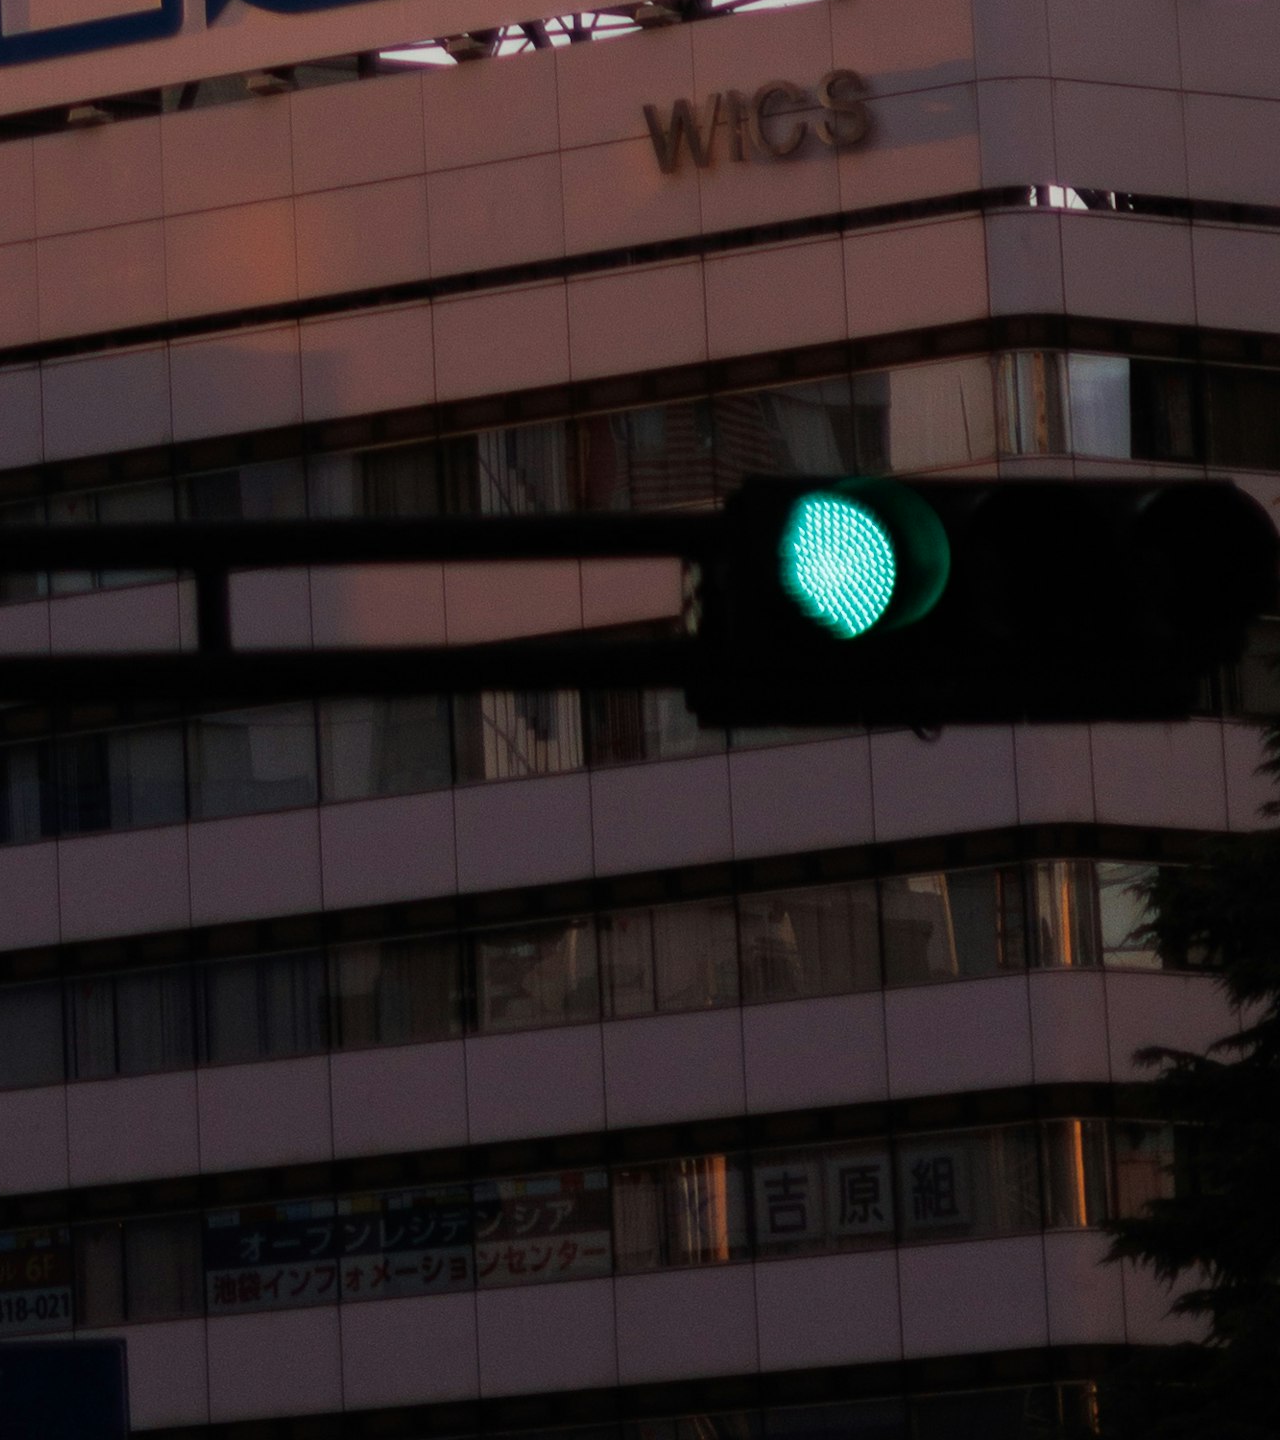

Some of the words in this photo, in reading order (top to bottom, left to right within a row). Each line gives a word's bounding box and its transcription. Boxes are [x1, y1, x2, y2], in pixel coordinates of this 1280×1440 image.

[642, 67, 872, 178] WICS
[764, 1156, 961, 1234] 吉原組
[240, 1198, 574, 1263] オープンレジデンシア
[25, 1254, 55, 1282] 6F
[213, 1239, 608, 1305] 池袋インフォメーションセンター
